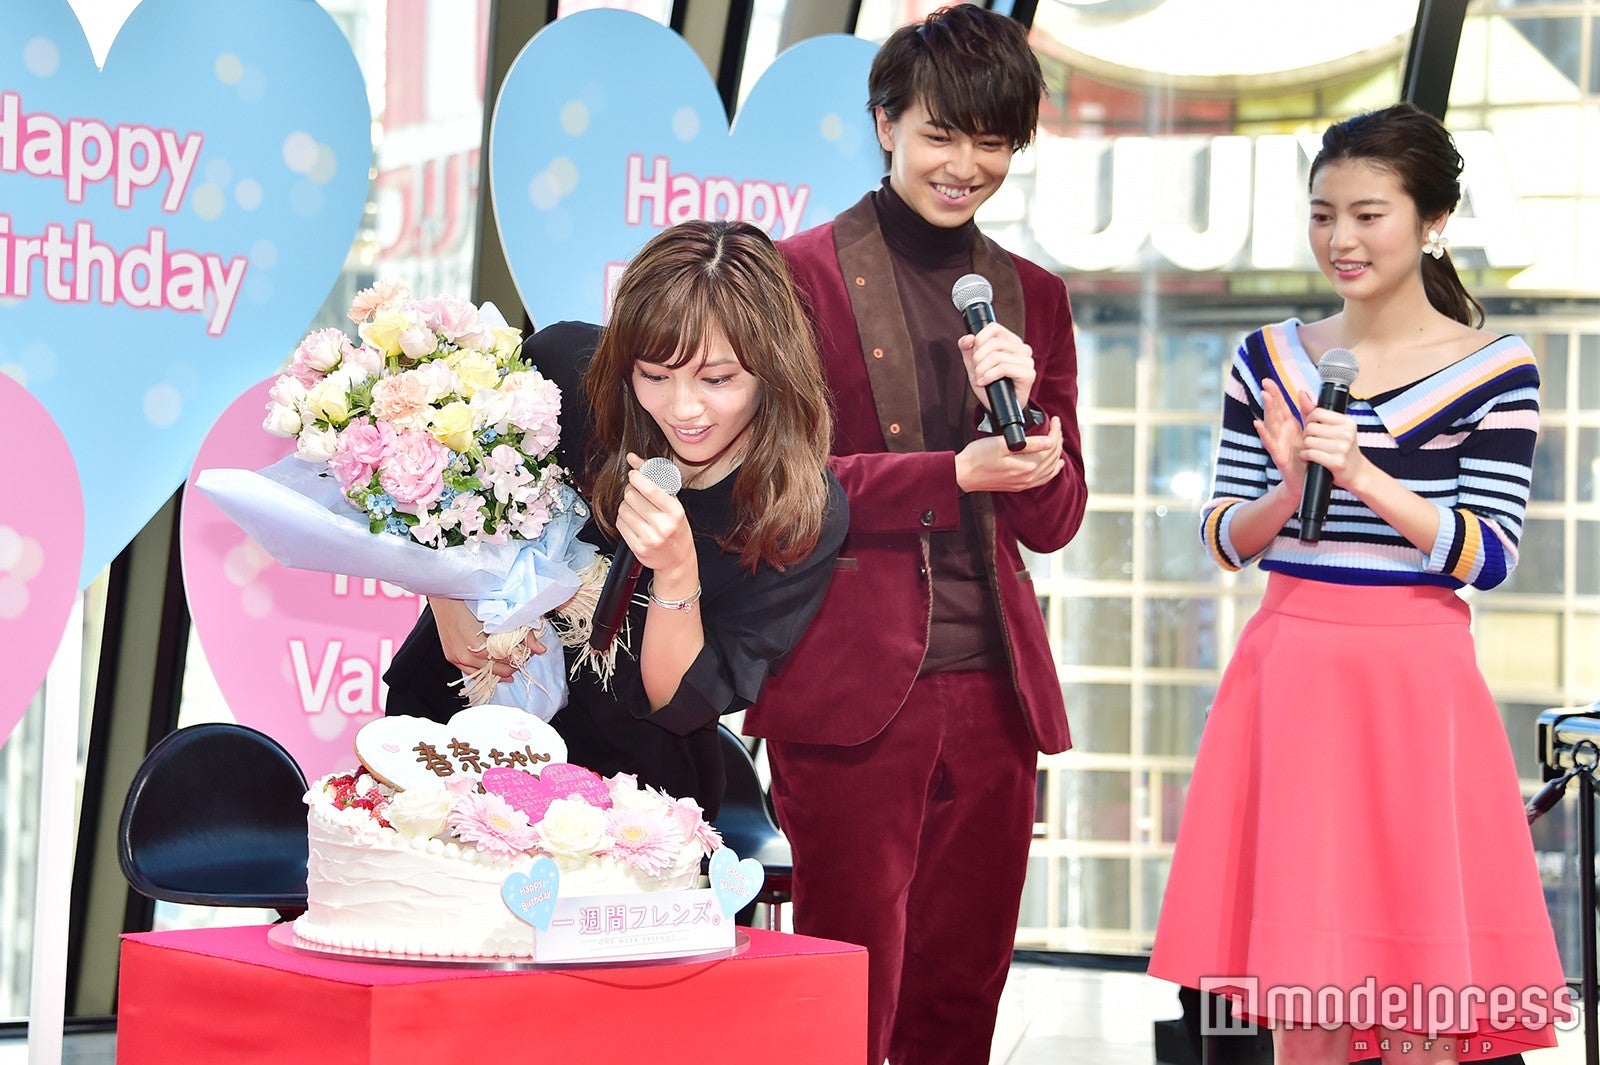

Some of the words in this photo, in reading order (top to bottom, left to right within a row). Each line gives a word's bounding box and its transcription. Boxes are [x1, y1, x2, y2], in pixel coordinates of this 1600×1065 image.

[626, 153, 810, 241] Happy
[0, 215, 248, 336] irthday
[412, 737, 551, 777] 春奈ちゃん
[518, 879, 545, 896] Happy
[520, 888, 552, 912] Birthday
[551, 898, 721, 935] 一週間フレンズ。
